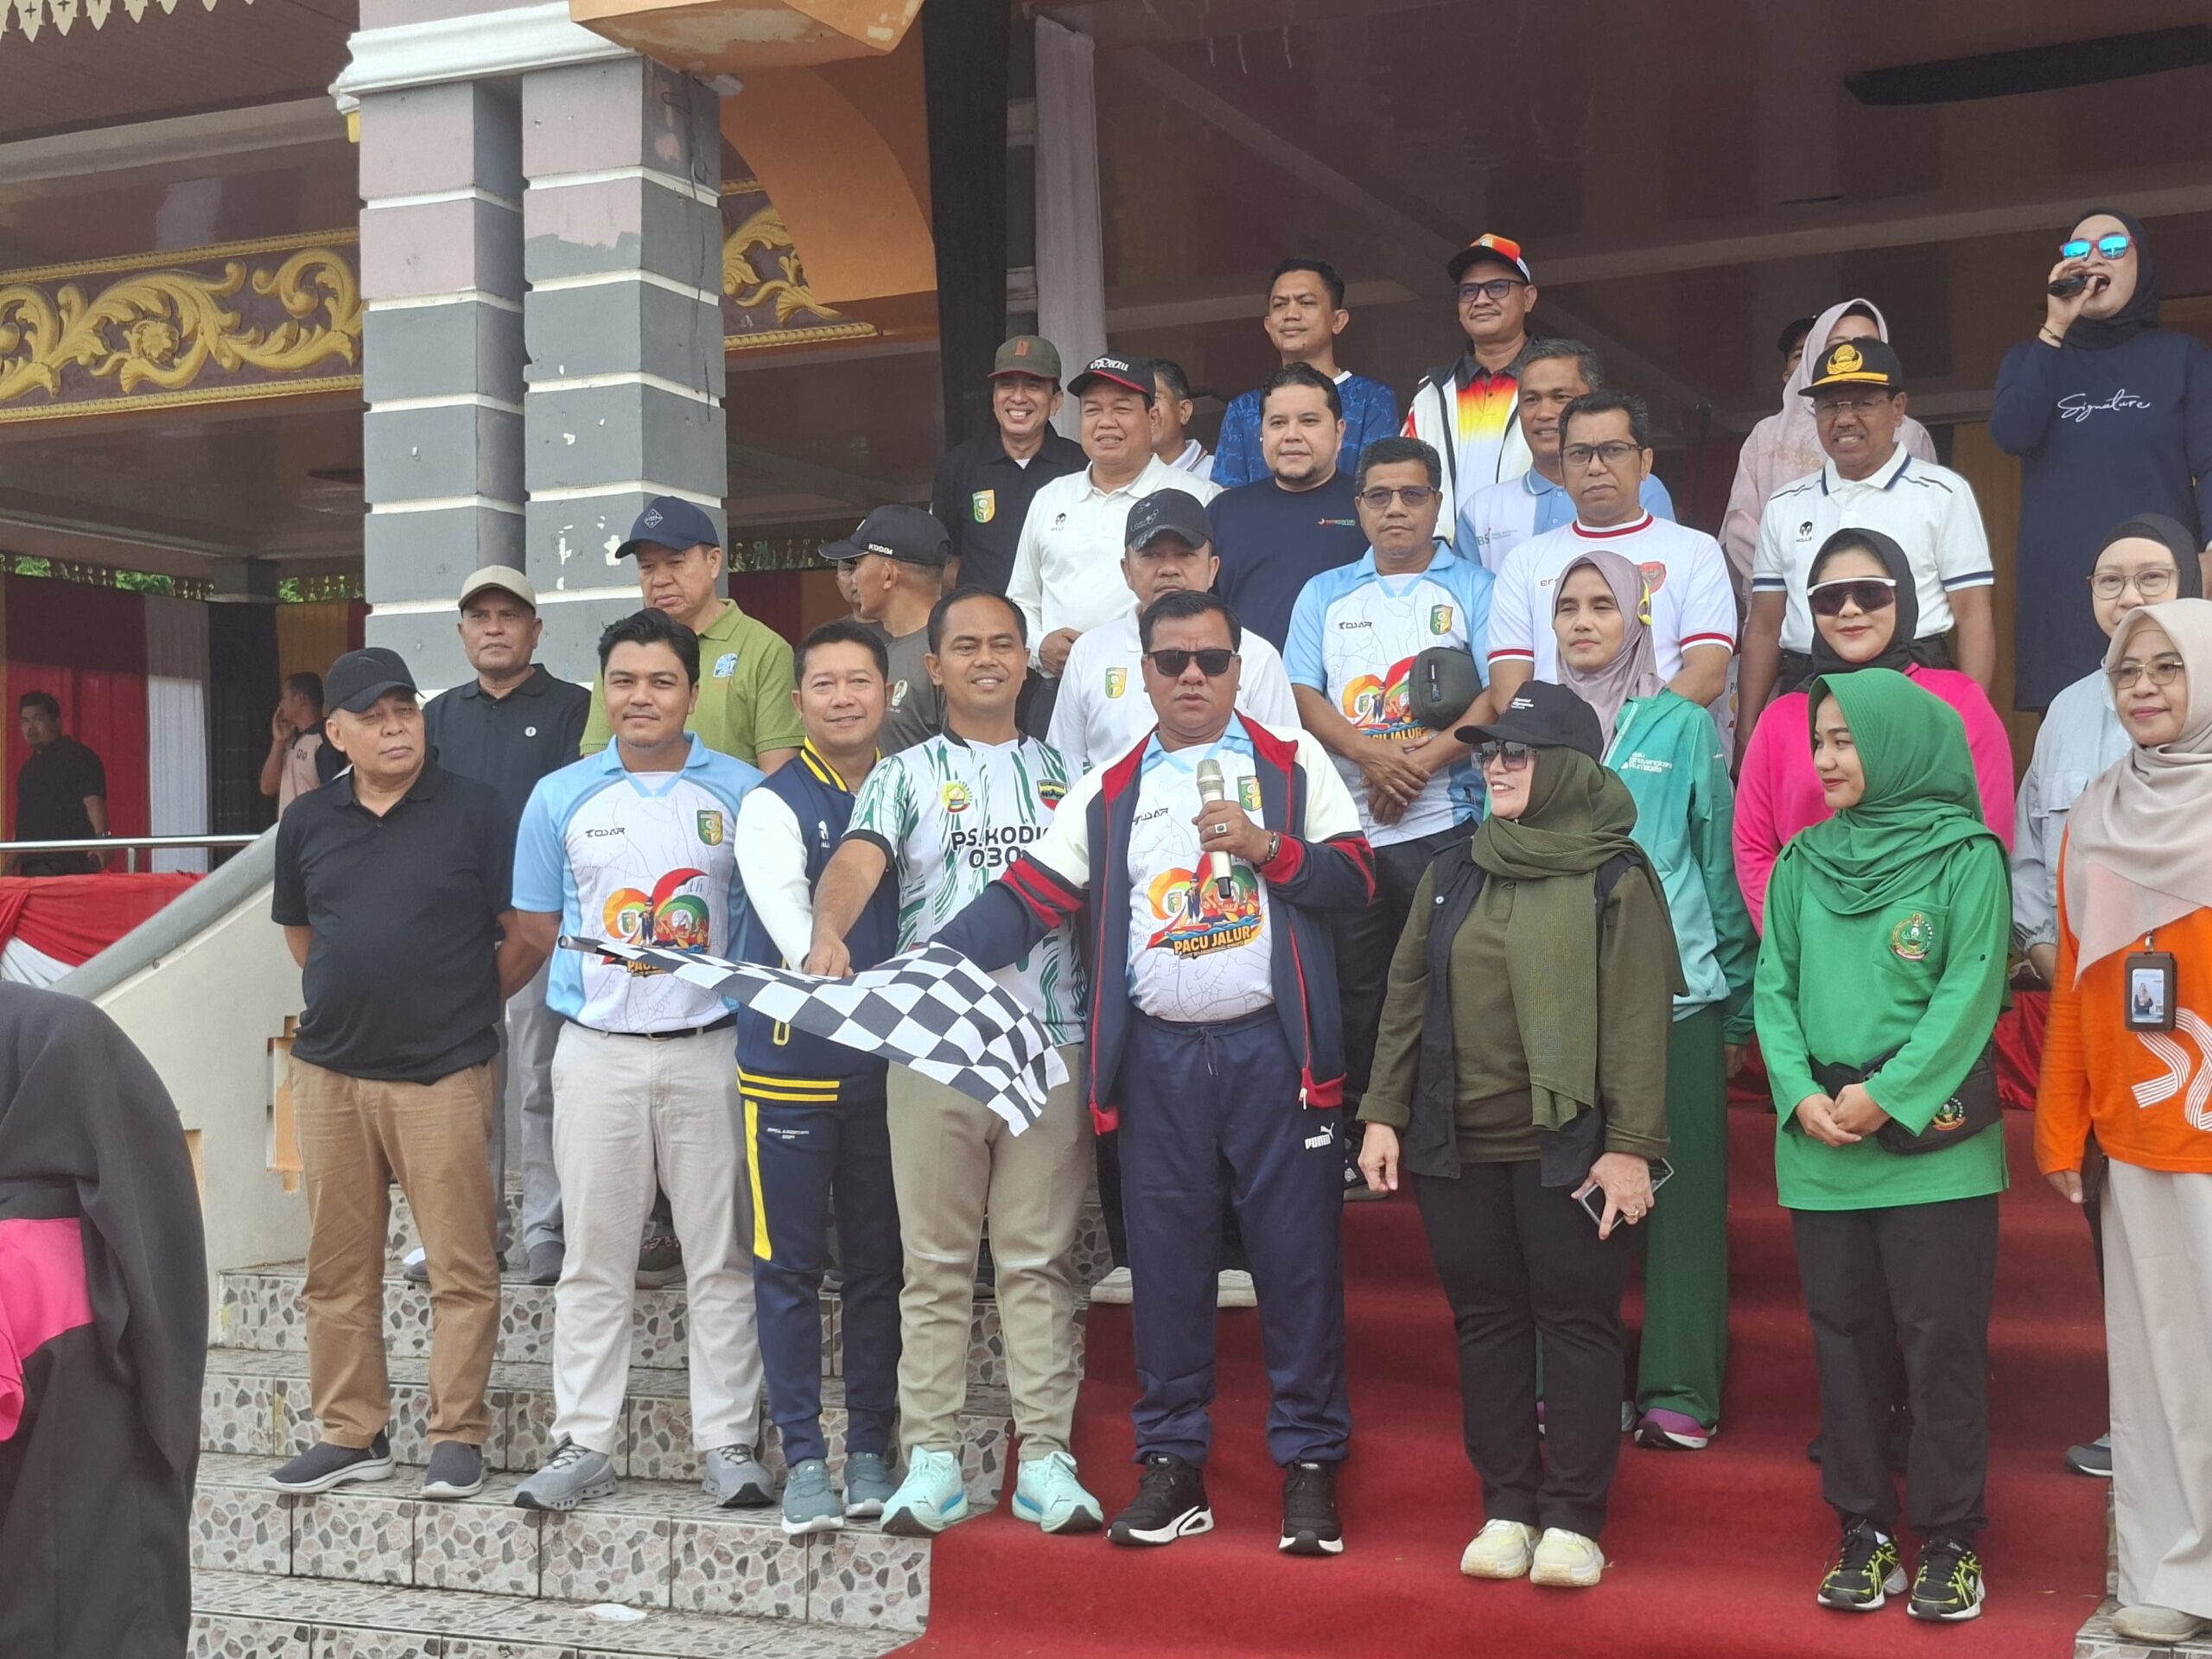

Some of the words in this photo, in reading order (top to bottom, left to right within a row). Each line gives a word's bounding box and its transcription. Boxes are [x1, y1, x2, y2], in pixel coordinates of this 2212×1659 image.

[2057, 388, 2151, 423] Signature
[868, 543, 893, 556] KODIM
[951, 825, 1049, 851] PS.KODI
[1173, 934, 1209, 955] PACU
[1211, 925, 1252, 948] JALUR
